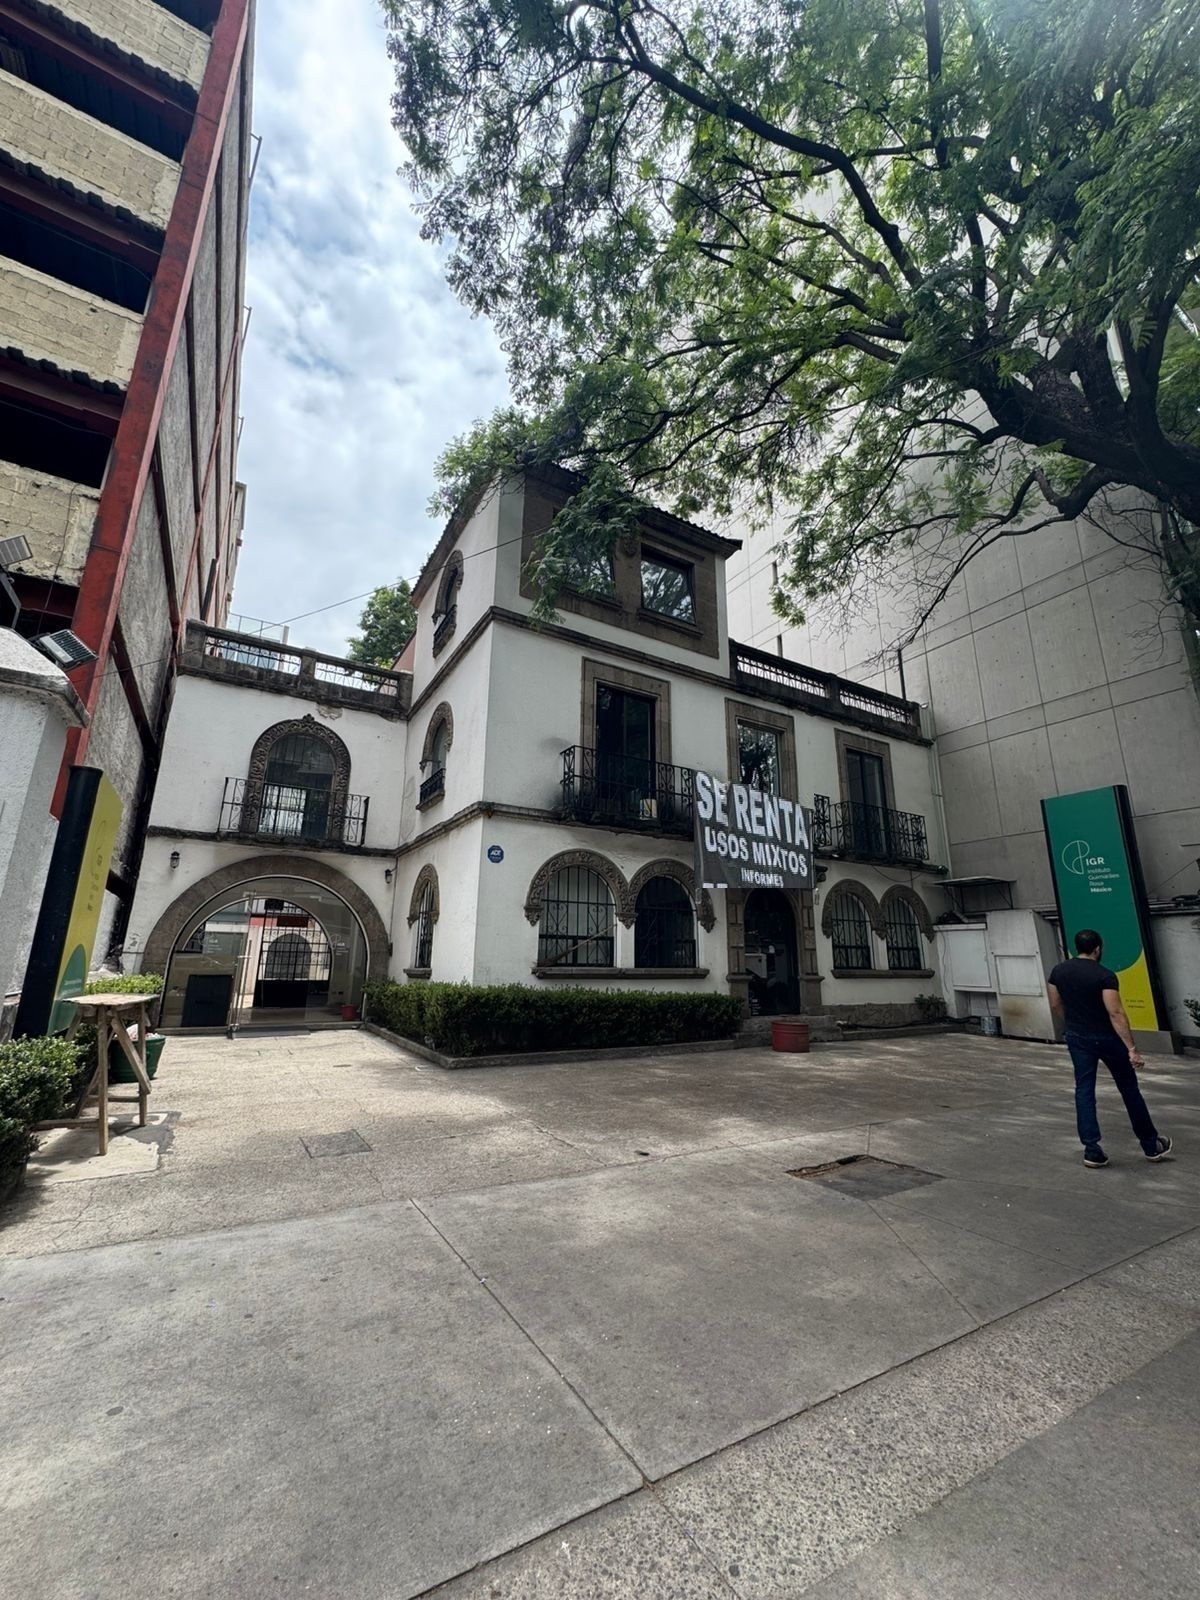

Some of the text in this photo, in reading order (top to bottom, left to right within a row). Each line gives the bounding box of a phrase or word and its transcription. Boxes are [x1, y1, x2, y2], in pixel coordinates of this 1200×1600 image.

[696, 771, 809, 850] SE RENTA
[704, 826, 808, 877] USOS MIXTOS
[1086, 856, 1105, 866] IGR
